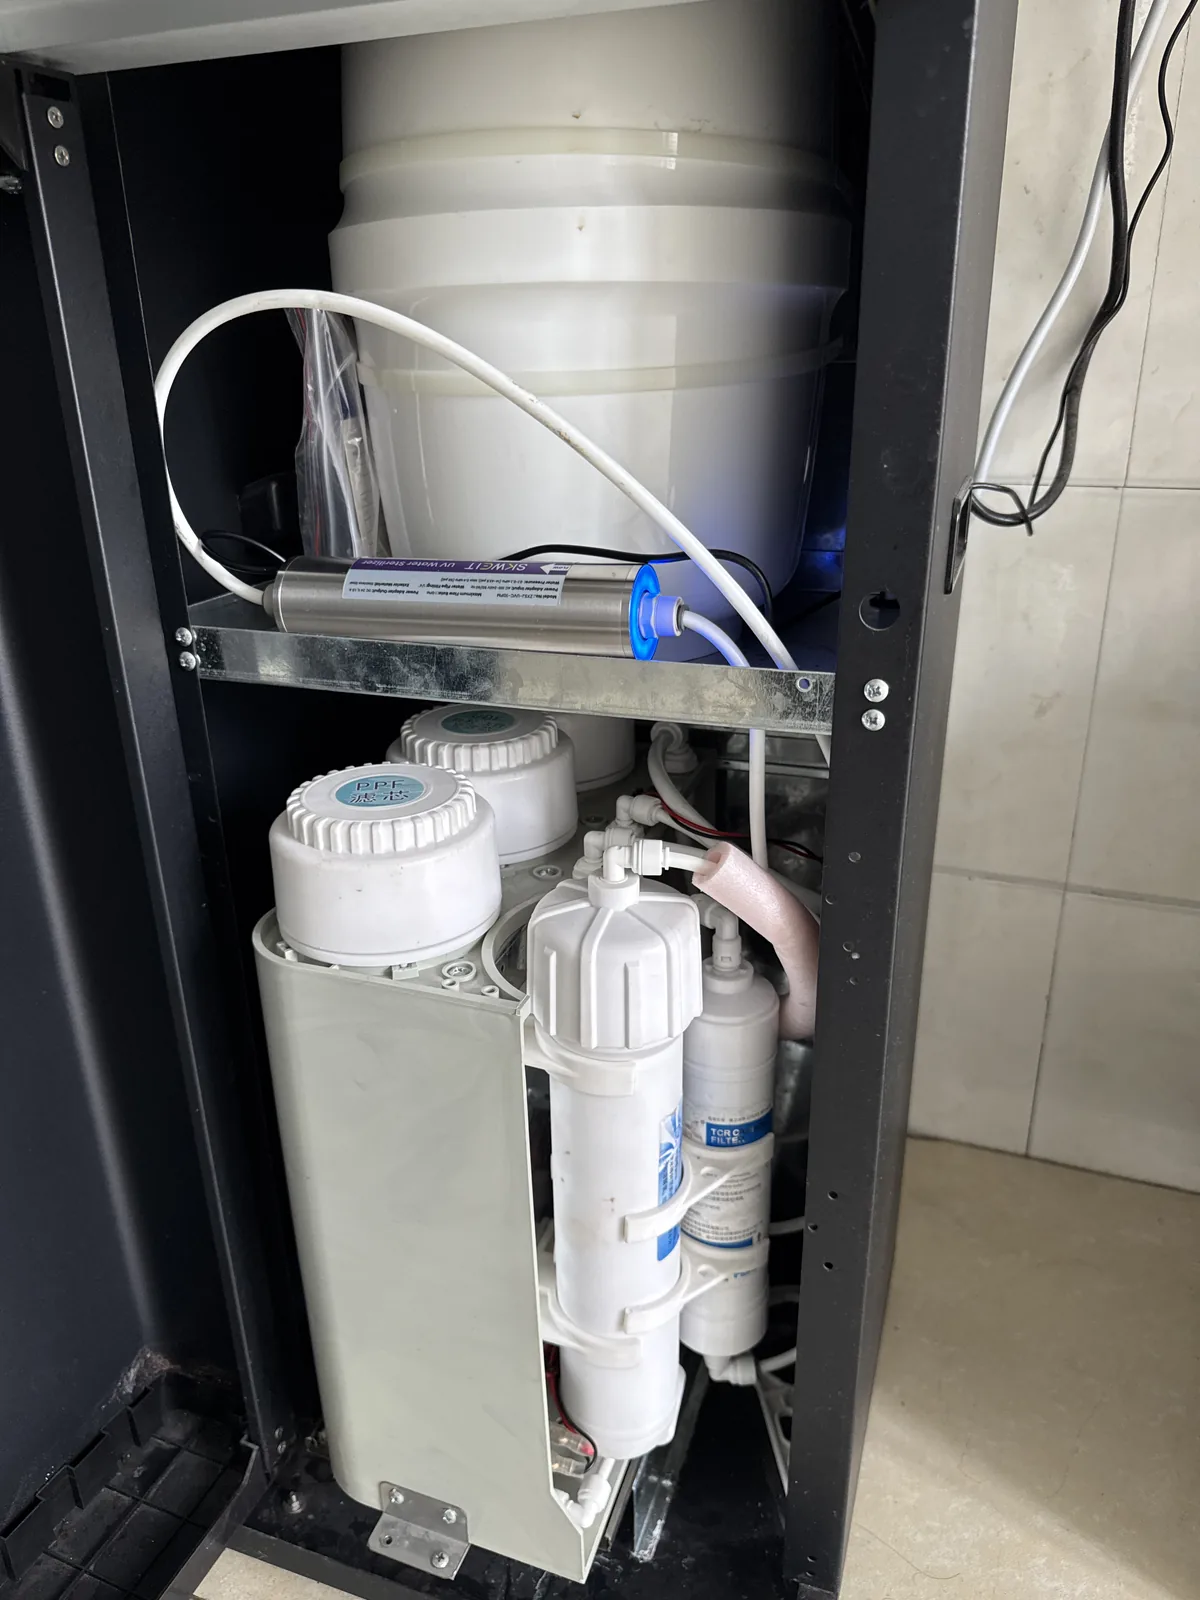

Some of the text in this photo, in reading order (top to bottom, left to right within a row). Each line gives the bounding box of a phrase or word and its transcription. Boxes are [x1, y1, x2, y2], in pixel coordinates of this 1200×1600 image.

[464, 562, 528, 571] SKWEIT
[356, 779, 405, 791] PPF
[349, 790, 410, 803] 滤芯
